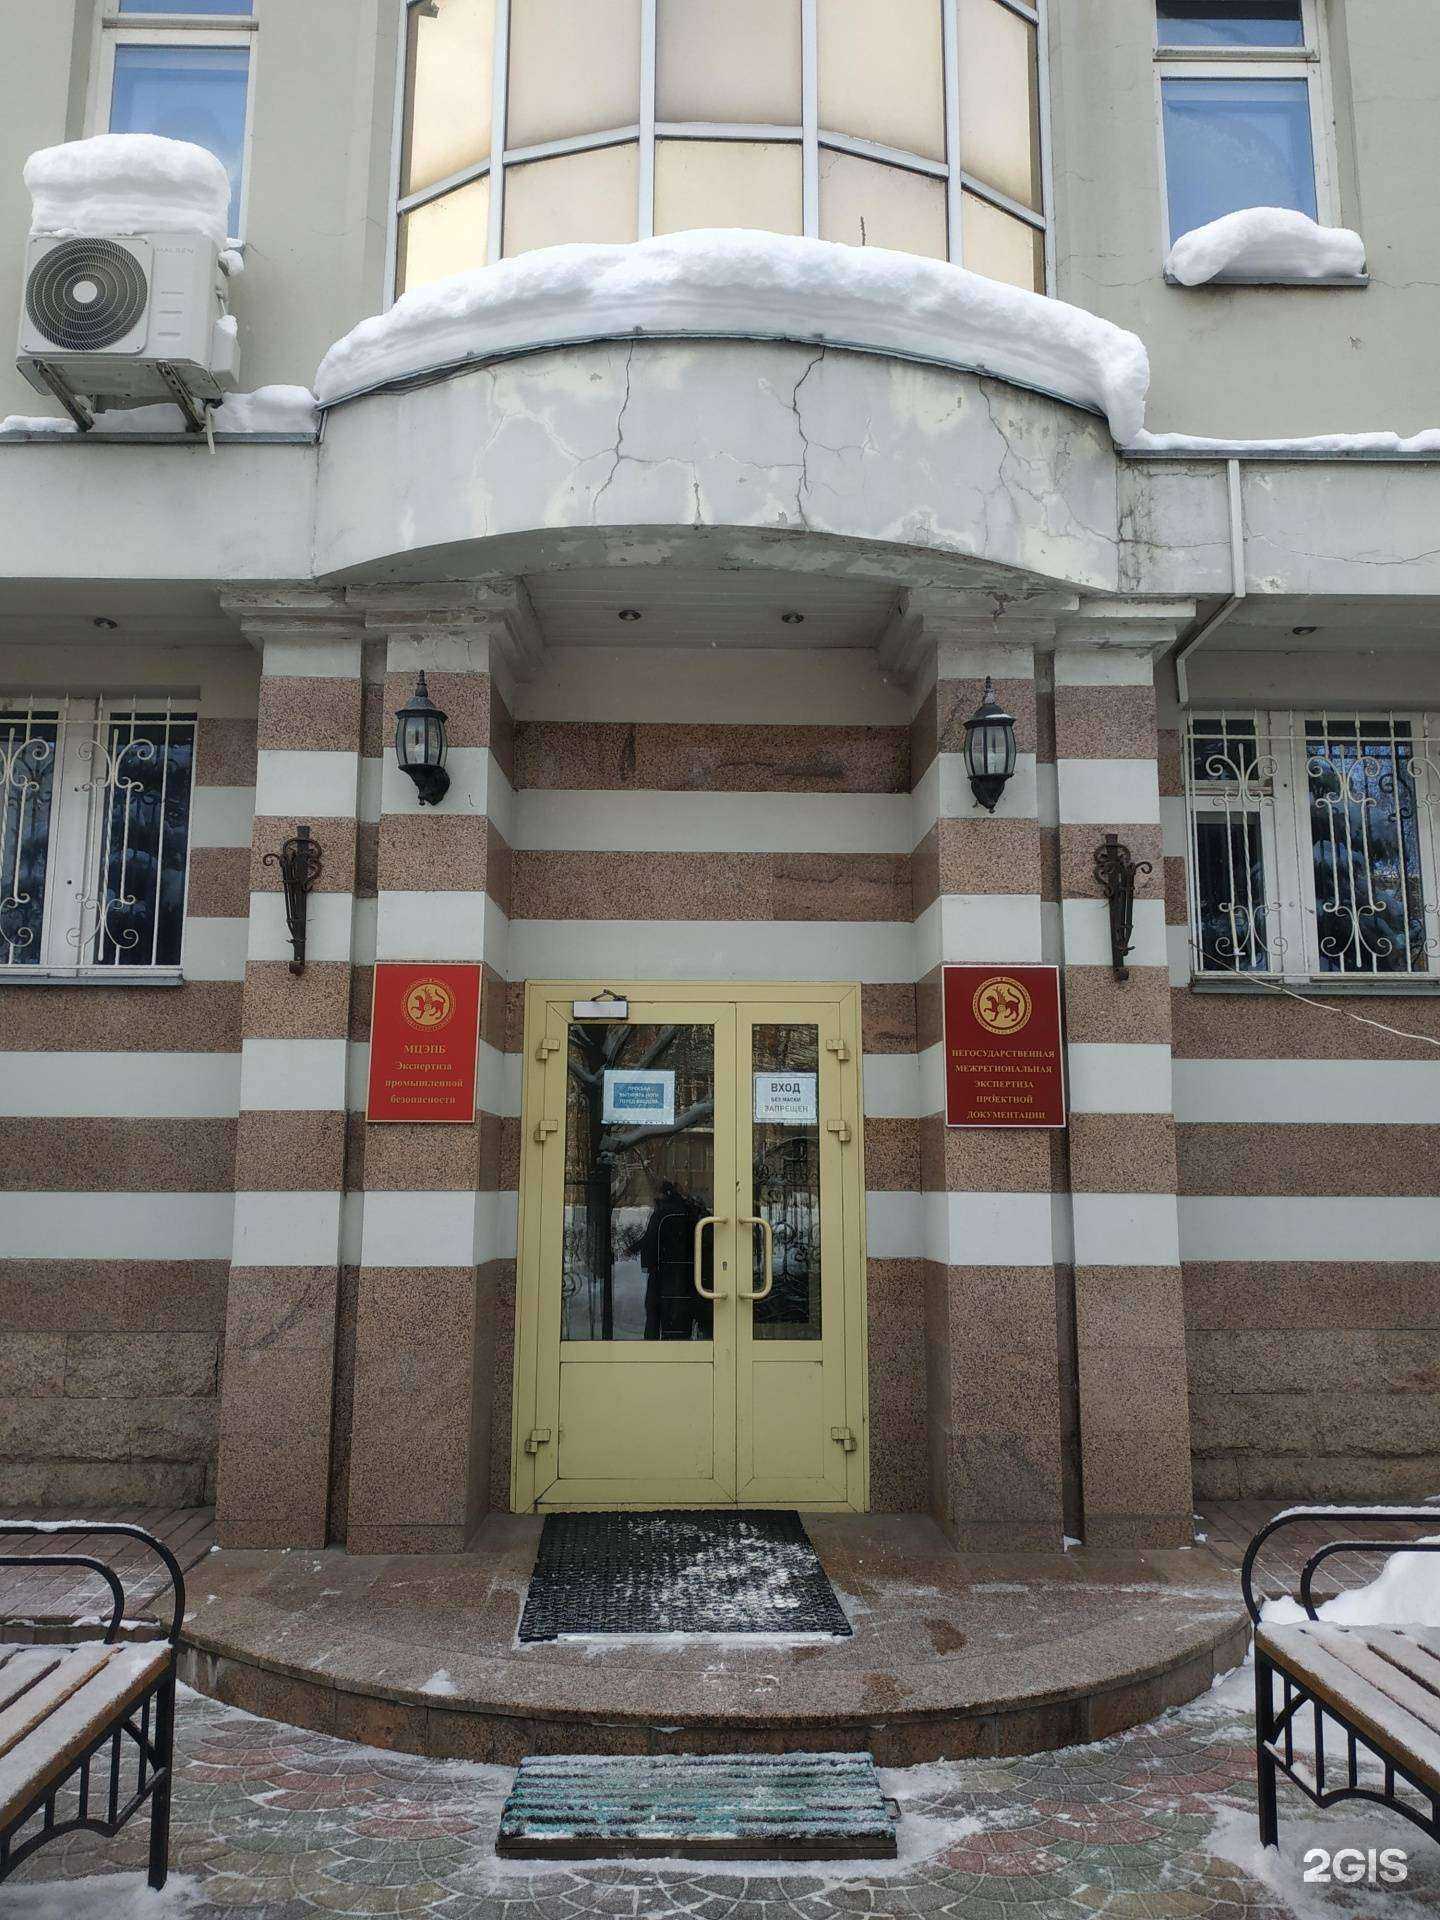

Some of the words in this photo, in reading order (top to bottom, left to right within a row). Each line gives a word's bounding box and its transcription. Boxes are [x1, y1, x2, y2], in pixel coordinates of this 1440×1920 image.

[952, 1050, 1055, 1058] НЕГОСУДАРСТВЕННАЯ
[395, 1061, 452, 1072] Экспертиза
[954, 1065, 1053, 1074] МЕЖРЕГИОНАЛЬНАЯ
[385, 1078, 463, 1088] промышленной
[974, 1080, 1034, 1088] ЭКСПЕРТИЗА
[771, 1082, 801, 1094] ВХОД
[390, 1094, 456, 1104] безопасности
[976, 1094, 1033, 1104] ПРОЕКТНОЙ
[764, 1105, 808, 1114] ЗАПРЕЩЕН
[966, 1111, 1046, 1120] ДОКУМЕНТАЦИИ
